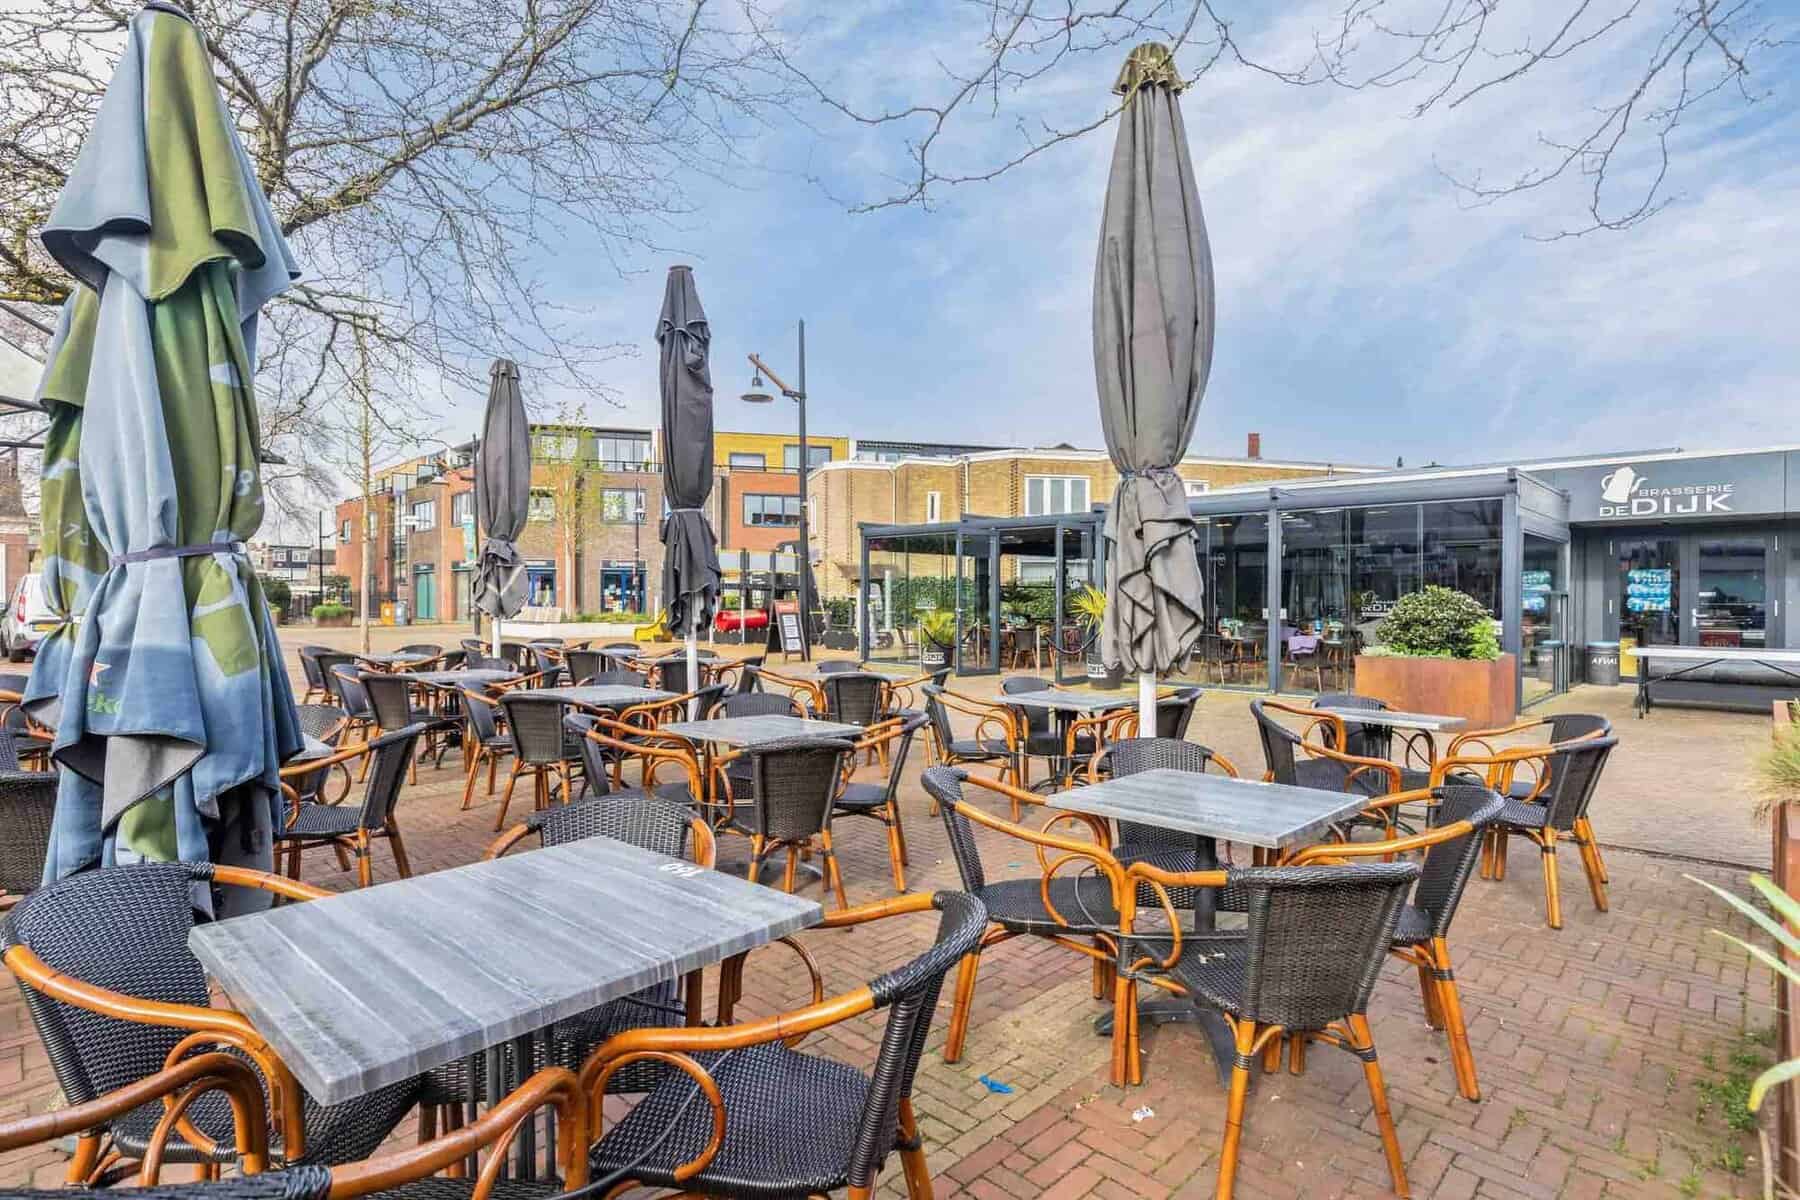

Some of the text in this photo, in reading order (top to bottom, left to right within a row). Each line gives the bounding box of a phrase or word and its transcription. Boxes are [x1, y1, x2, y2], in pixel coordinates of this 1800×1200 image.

[1639, 483, 1735, 497] BRASSERIE
[1600, 494, 1734, 517] DE DIJK
